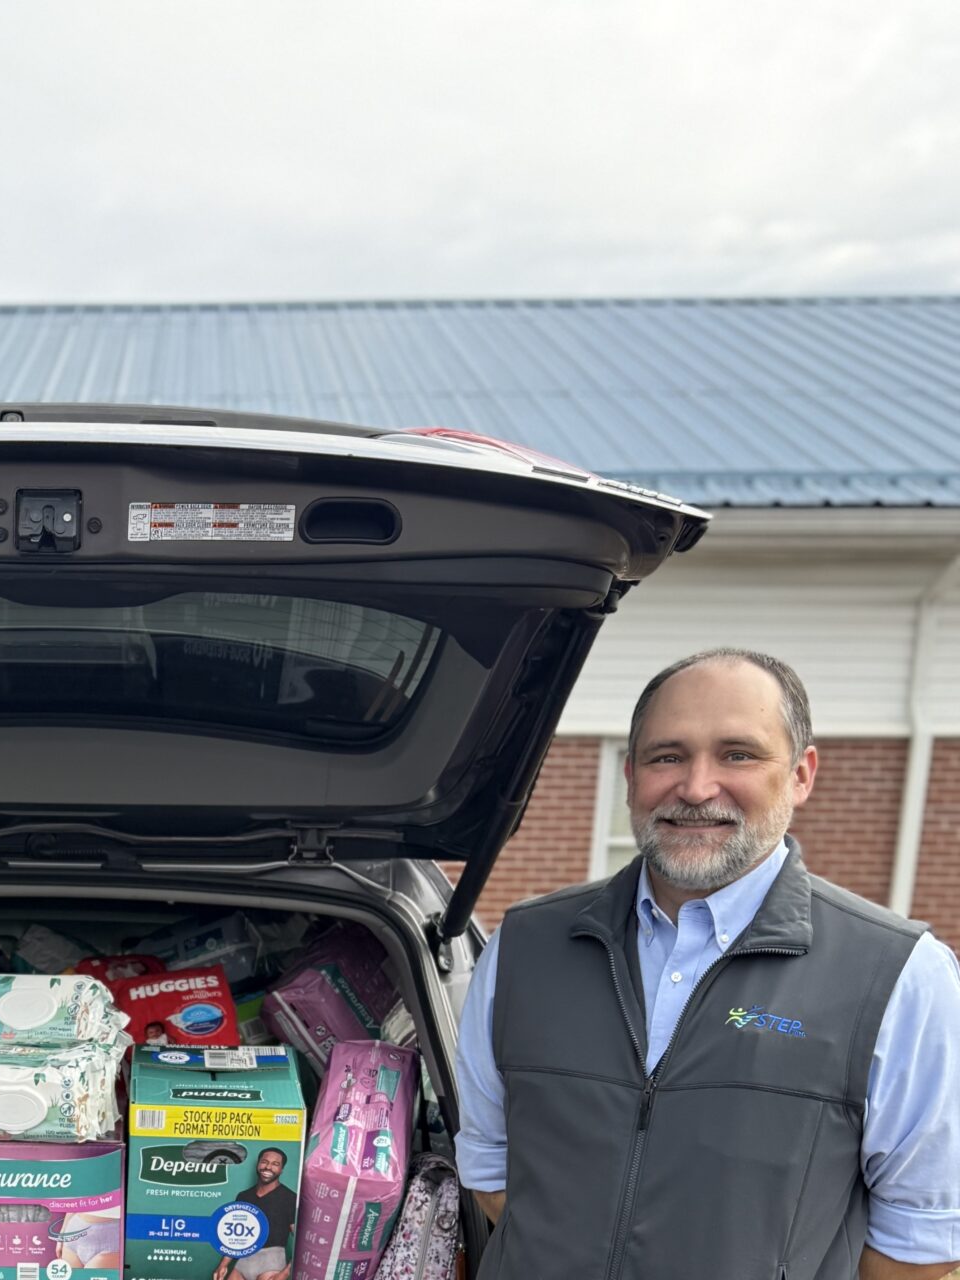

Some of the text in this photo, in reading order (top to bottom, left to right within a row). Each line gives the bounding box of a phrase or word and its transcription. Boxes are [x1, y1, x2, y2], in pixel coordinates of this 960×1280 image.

[129, 975, 219, 1001] HUGGIES
[754, 1013, 802, 1033] STEP
[183, 1111, 253, 1124] STOCK UP PACK
[173, 1123, 261, 1137] FORMAT PROVISION
[49, 1200, 78, 1209] discreet
[88, 1199, 98, 1207] for
[100, 1195, 113, 1204] her
[161, 1219, 186, 1230] L G
[223, 1222, 255, 1237] 30x
[51, 1264, 67, 1275] 54
